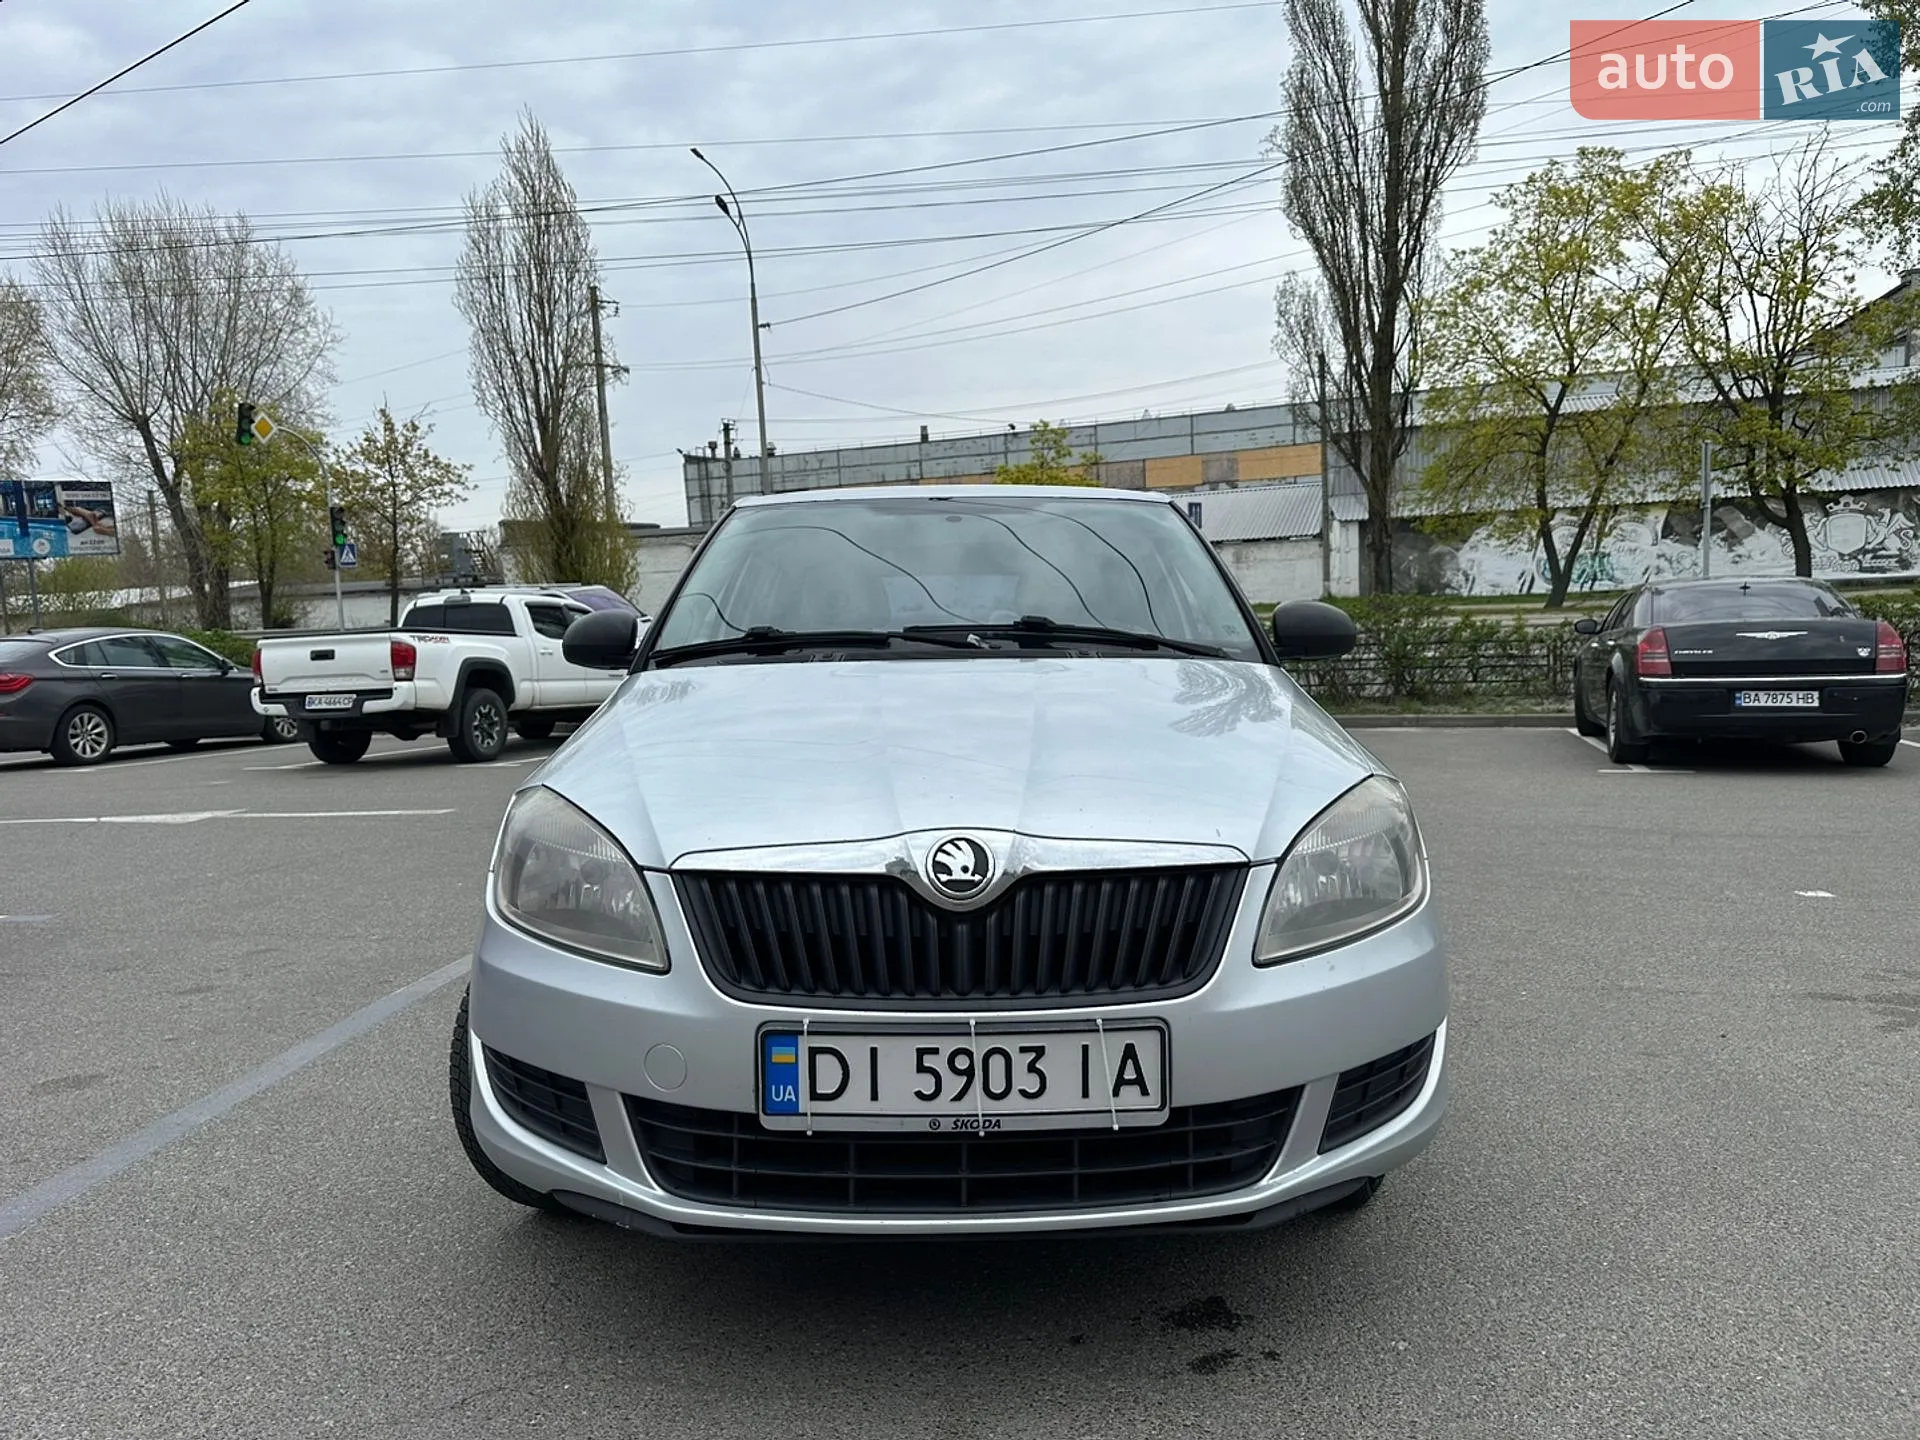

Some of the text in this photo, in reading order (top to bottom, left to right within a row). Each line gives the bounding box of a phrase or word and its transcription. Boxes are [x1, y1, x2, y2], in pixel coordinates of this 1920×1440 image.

[1742, 692, 1815, 704] BA 7875 HB
[808, 1042, 1151, 1102] DI 5903 IA
[771, 1084, 797, 1102] UA
